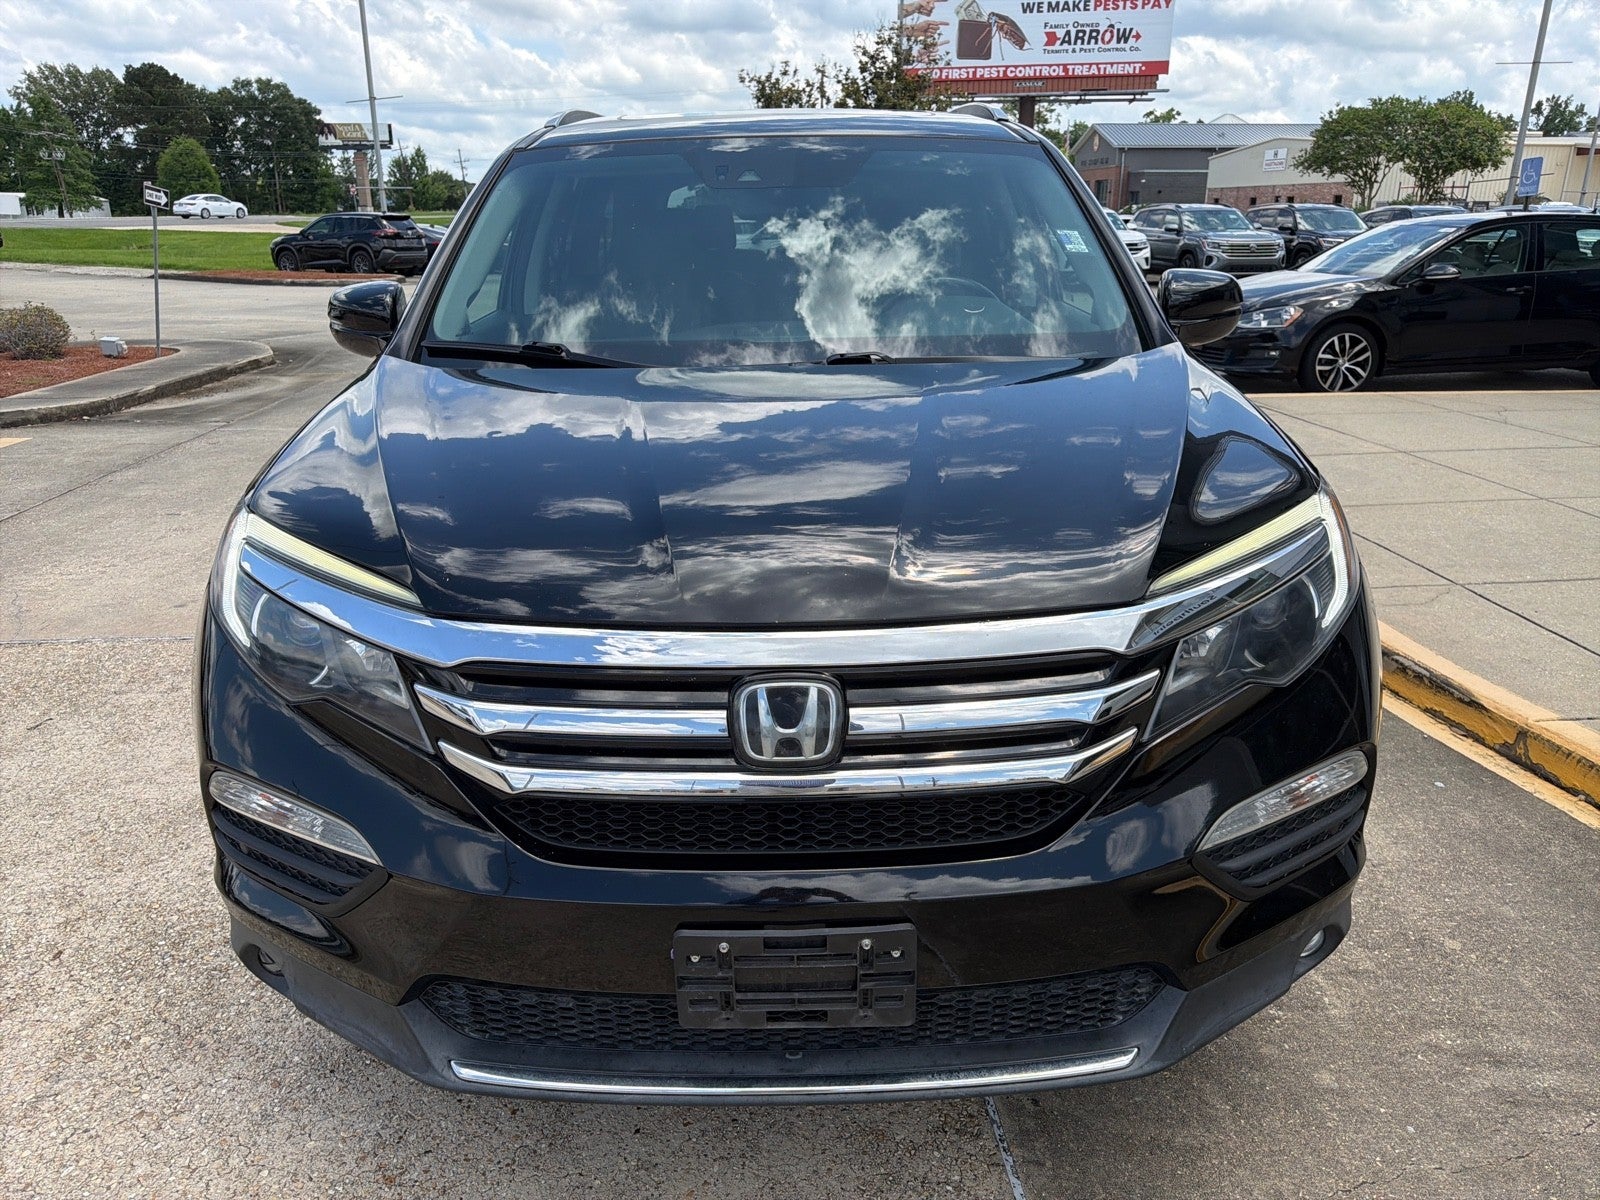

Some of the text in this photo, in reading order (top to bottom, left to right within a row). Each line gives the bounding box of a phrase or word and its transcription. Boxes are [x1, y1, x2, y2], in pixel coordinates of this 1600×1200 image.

[1021, 0, 1172, 14] WE MAKE PESTS PAY
[1060, 27, 1133, 46] ARROW
[941, 68, 975, 79] FIRST
[976, 67, 1005, 78] PEST
[1007, 65, 1065, 77] CONTROL
